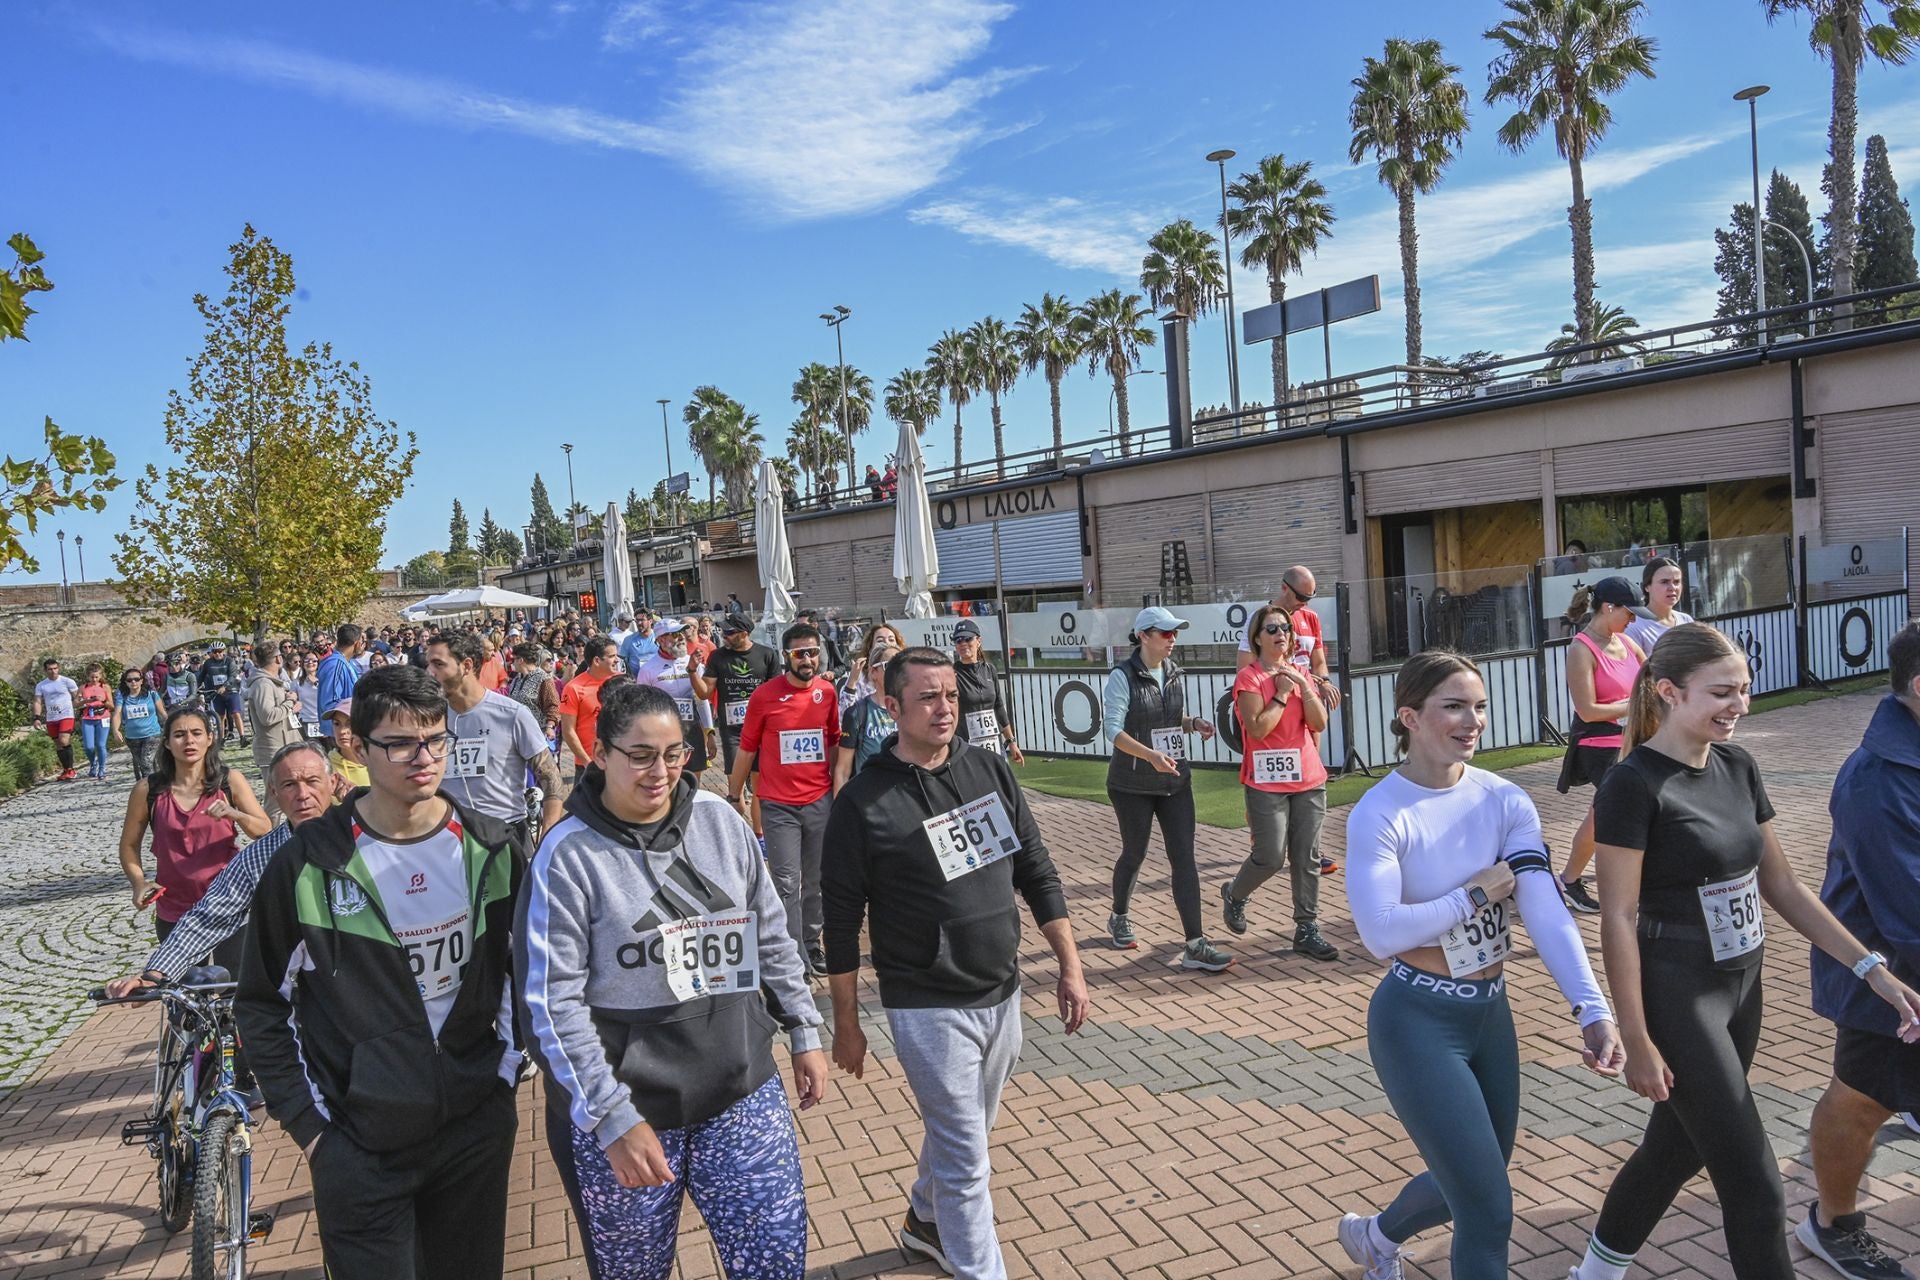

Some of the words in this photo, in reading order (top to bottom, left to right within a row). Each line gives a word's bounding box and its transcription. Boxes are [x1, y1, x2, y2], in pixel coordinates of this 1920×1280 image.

[985, 485, 1055, 518] LALOLA
[1843, 565, 1869, 577] LALOLA
[1051, 635, 1087, 646] LALOLA
[680, 703, 691, 713] 82
[733, 706, 745, 717] 48
[976, 715, 995, 729] 163
[793, 736, 819, 753] 429
[1163, 734, 1183, 750] 199
[1266, 756, 1295, 772] 553
[968, 798, 995, 813] DEPORTE
[948, 811, 999, 853] 561
[1703, 887, 1727, 897] GRUPO
[1729, 888, 1759, 930] 581
[404, 928, 433, 938] SALUD
[440, 913, 469, 931] DEPORTE
[716, 916, 752, 927] DEPORTE
[1463, 902, 1507, 946] 582
[403, 930, 464, 976] 570
[682, 931, 744, 971] 569
[1411, 973, 1478, 998] PRO
